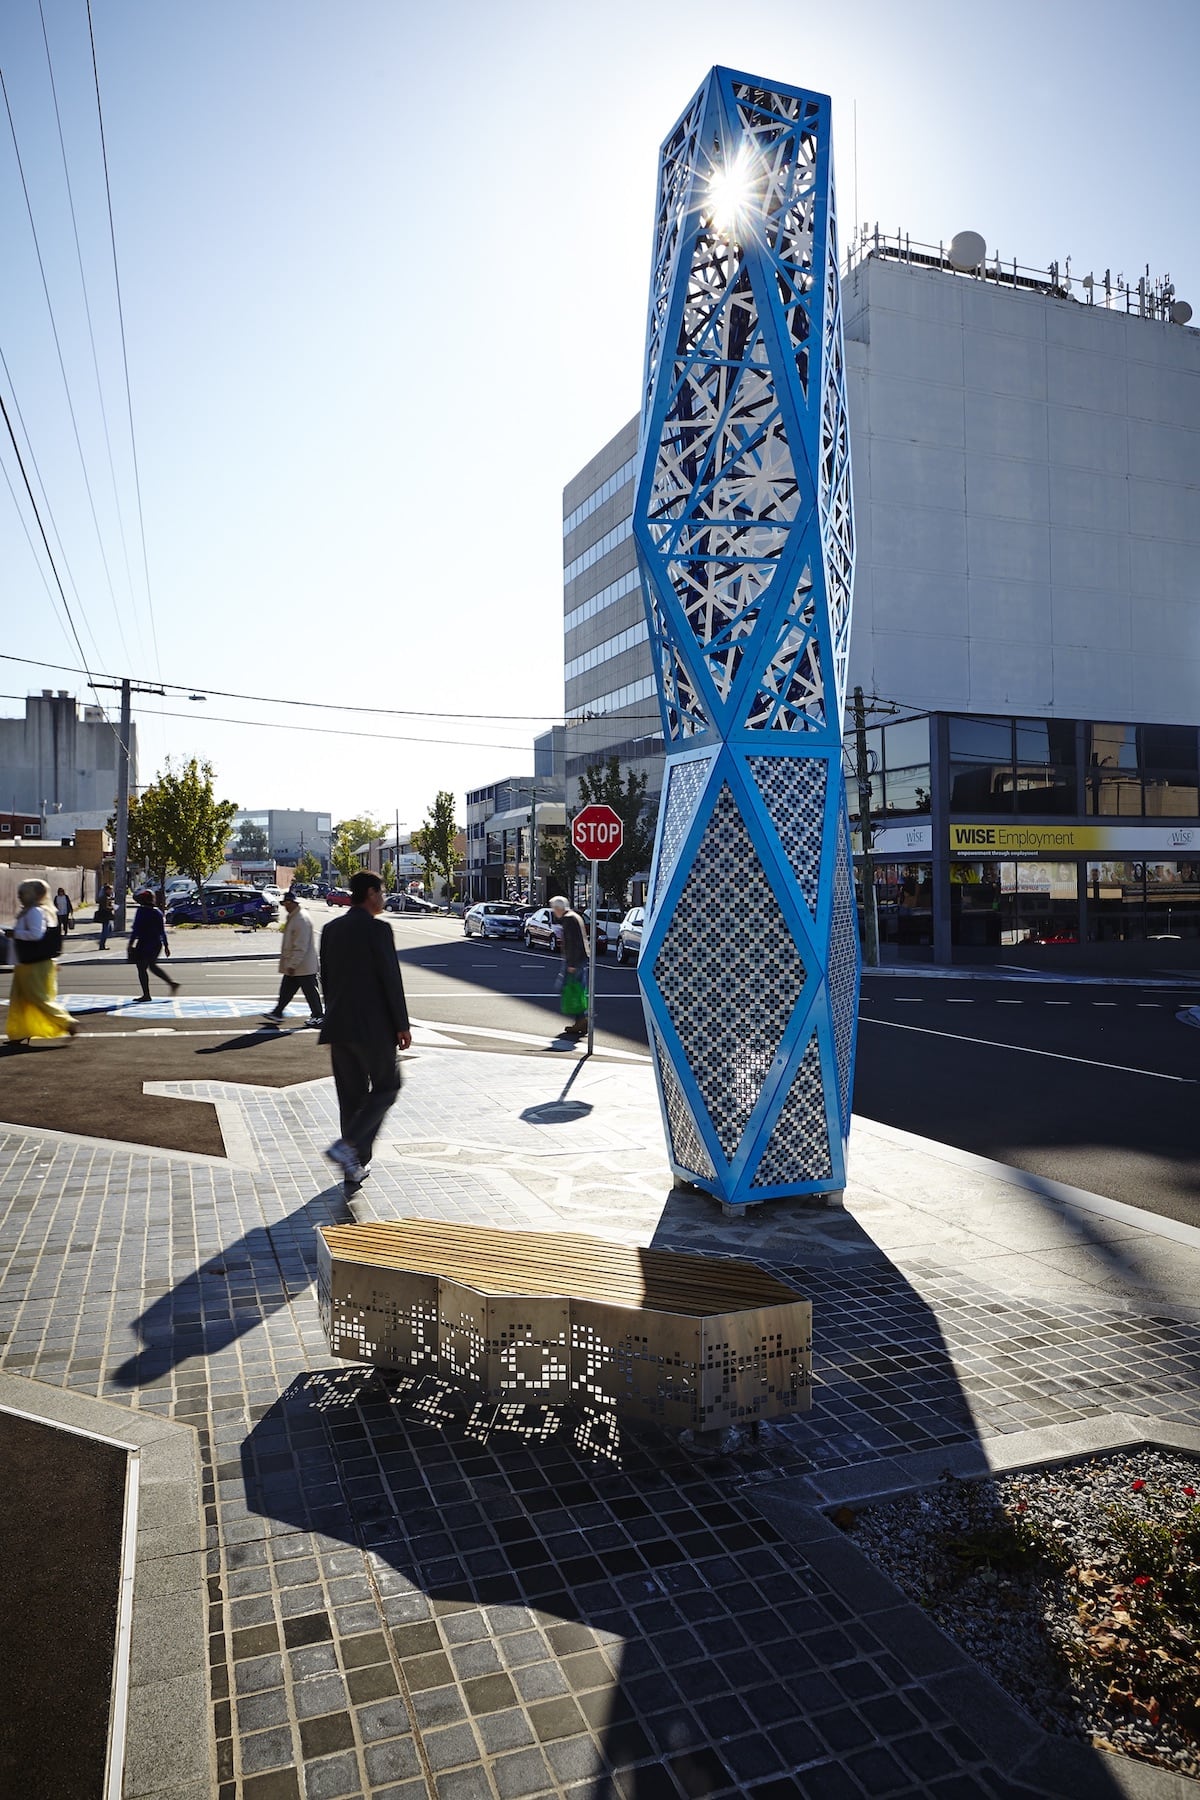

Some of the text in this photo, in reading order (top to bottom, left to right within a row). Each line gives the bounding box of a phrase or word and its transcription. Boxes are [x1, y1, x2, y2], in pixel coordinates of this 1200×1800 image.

[576, 822, 620, 843] STOP
[955, 829, 1075, 847] WISE Employment
